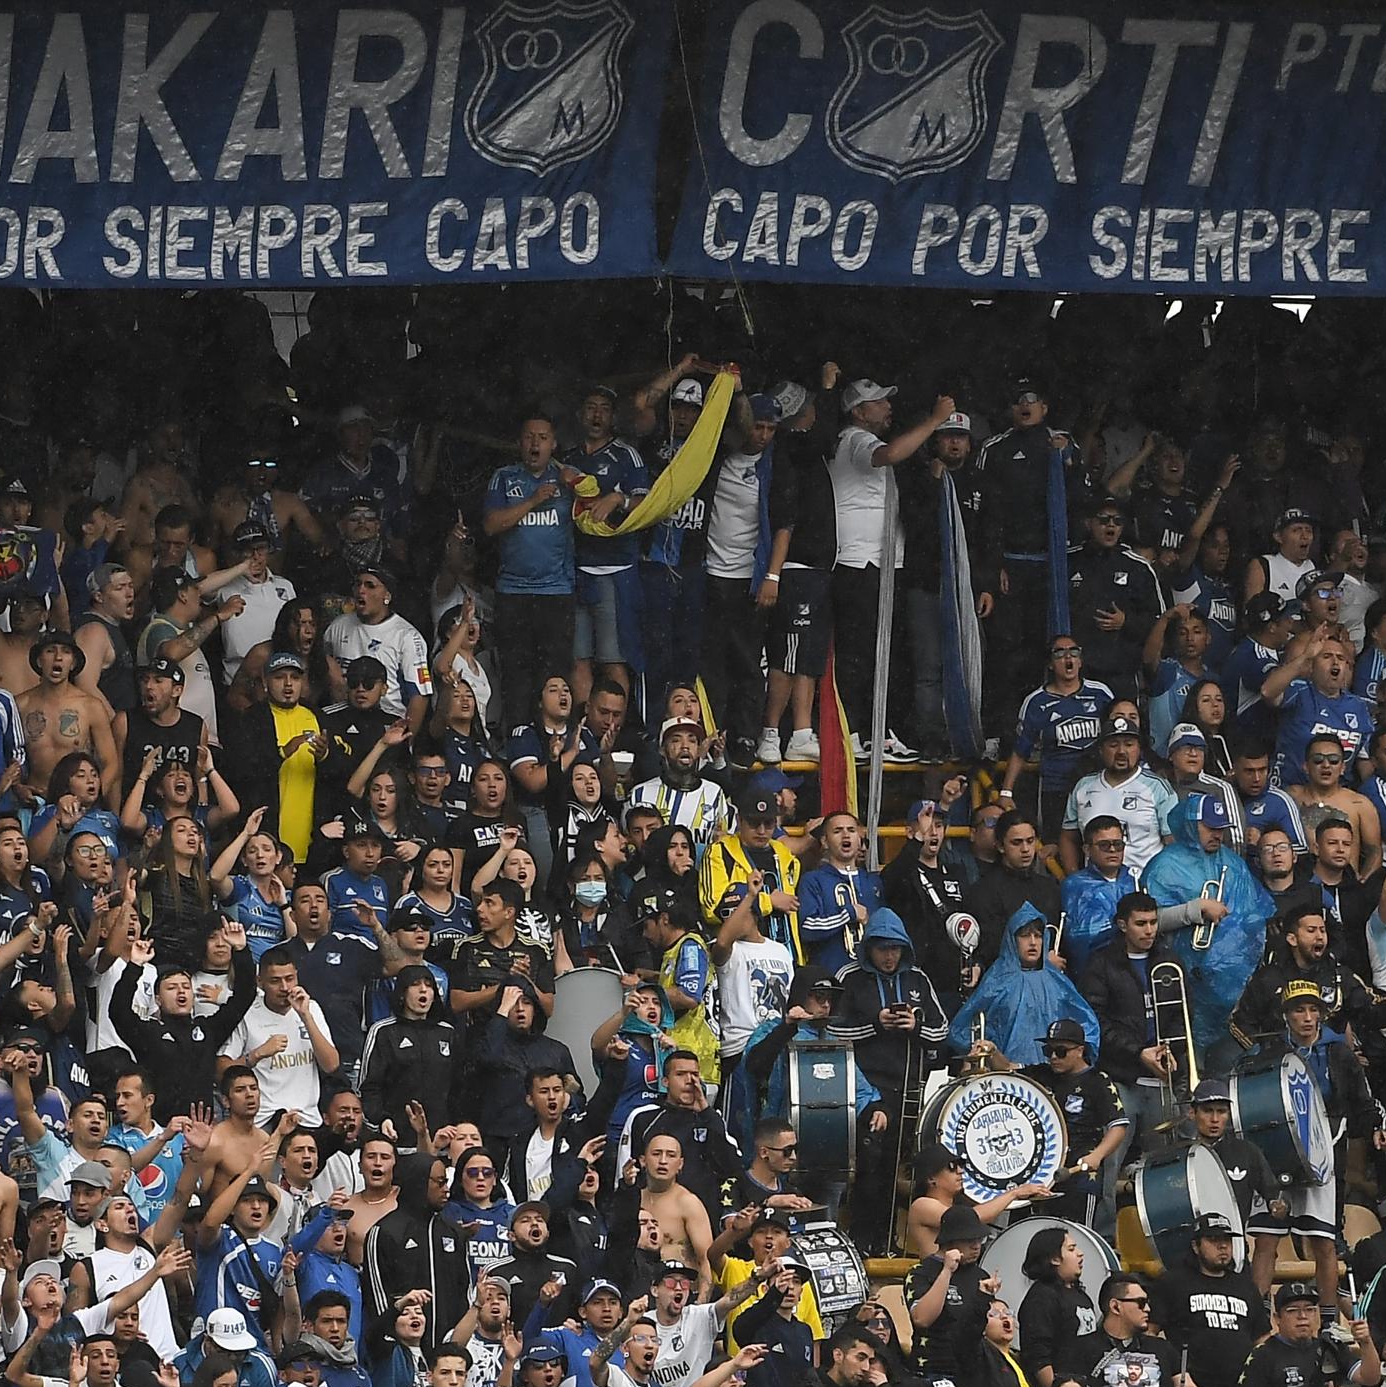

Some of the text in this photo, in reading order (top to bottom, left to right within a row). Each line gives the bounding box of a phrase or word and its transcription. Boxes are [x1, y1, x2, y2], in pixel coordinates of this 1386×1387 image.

[102, 202, 389, 280] SIEMPRE
[425, 191, 601, 273] CAPO
[703, 187, 1371, 283] CAPO POR SIEMPRE
[1057, 721, 1102, 746] ANDINA
[468, 1241, 510, 1258] EONA
[1190, 1295, 1225, 1313] SUMMER
[1206, 1312, 1219, 1329] TO
